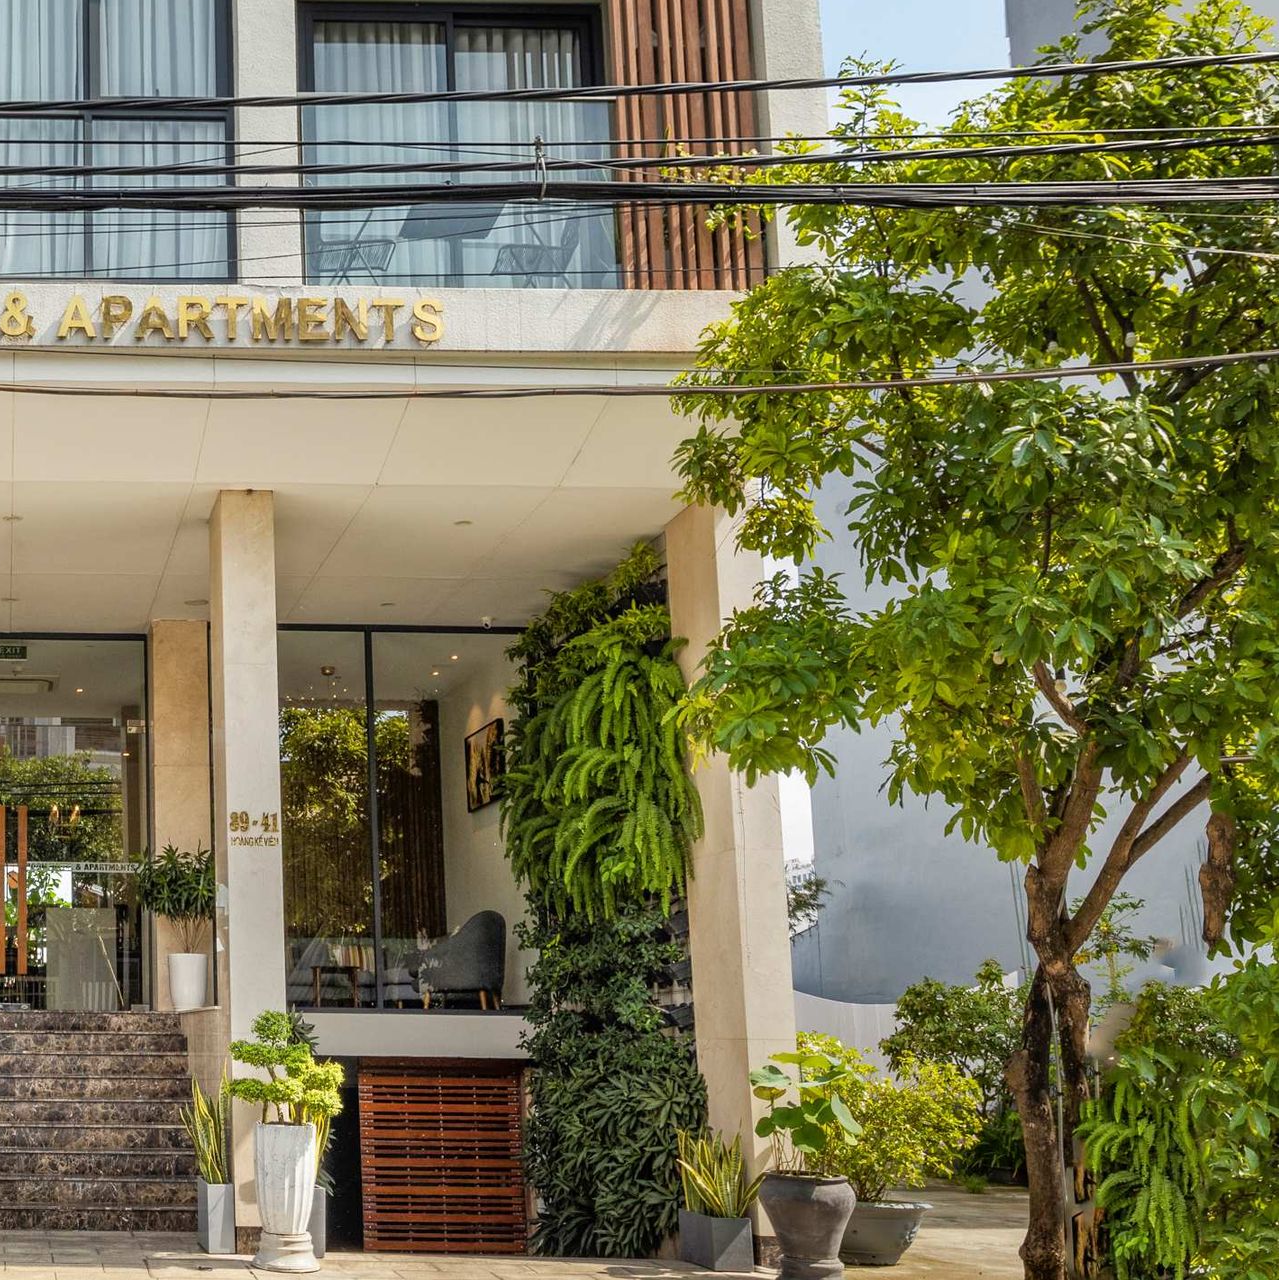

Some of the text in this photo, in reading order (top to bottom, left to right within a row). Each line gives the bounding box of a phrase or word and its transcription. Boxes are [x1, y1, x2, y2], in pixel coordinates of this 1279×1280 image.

[0, 292, 37, 338] &
[57, 294, 446, 343] APARTMENTS
[0, 646, 21, 654] EXIT
